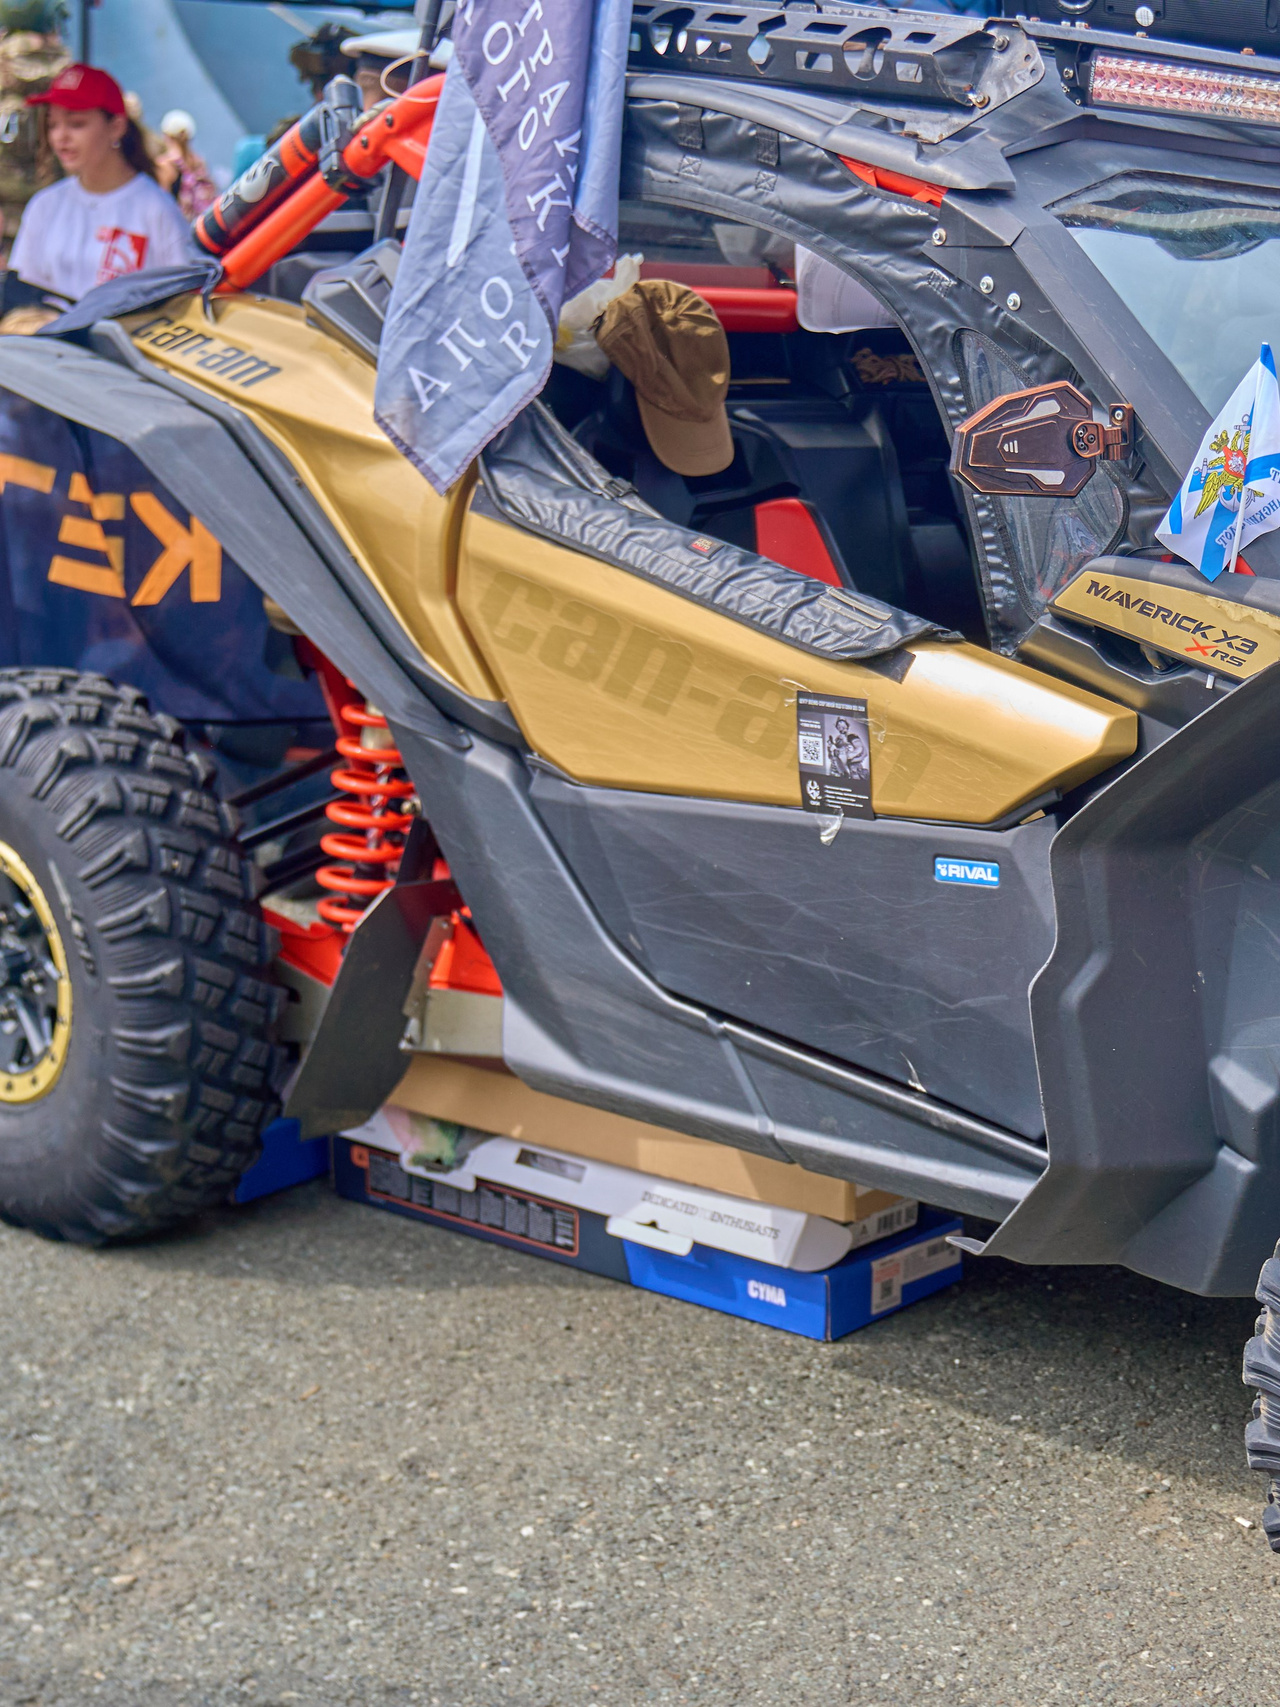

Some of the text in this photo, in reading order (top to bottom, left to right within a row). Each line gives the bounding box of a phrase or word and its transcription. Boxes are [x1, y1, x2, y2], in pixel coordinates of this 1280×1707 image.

[131, 317, 281, 387] can-am
[1086, 579, 1259, 655] MAVERICK X3
[947, 864, 998, 882] RIVAL
[747, 1279, 787, 1307] CYMA
